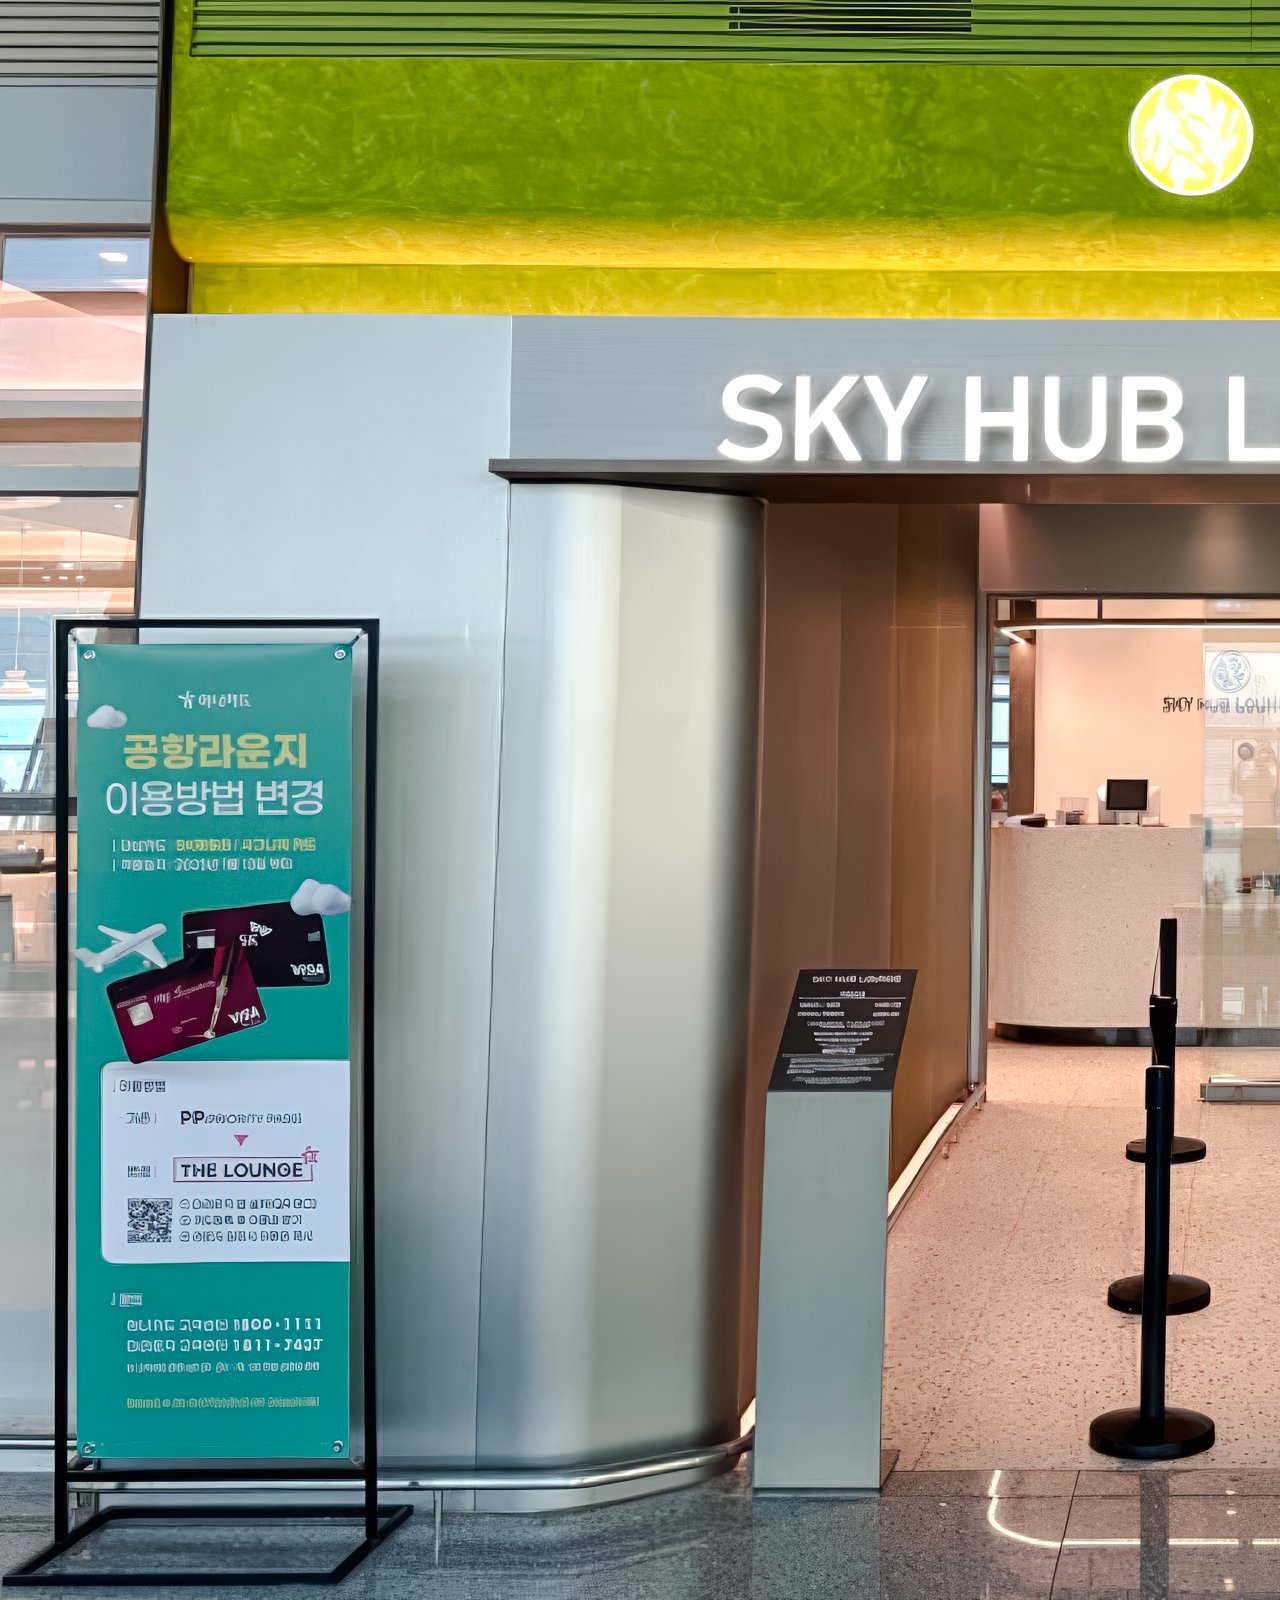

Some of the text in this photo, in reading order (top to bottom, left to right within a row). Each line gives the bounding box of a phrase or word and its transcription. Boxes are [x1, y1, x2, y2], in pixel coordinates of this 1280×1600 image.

[717, 374, 929, 463] SKY
[964, 375, 1184, 463] HUB
[123, 732, 307, 770] 공항라운지
[105, 780, 324, 816] 이용방법 변경
[181, 1163, 303, 1178] THE LOUNGE
